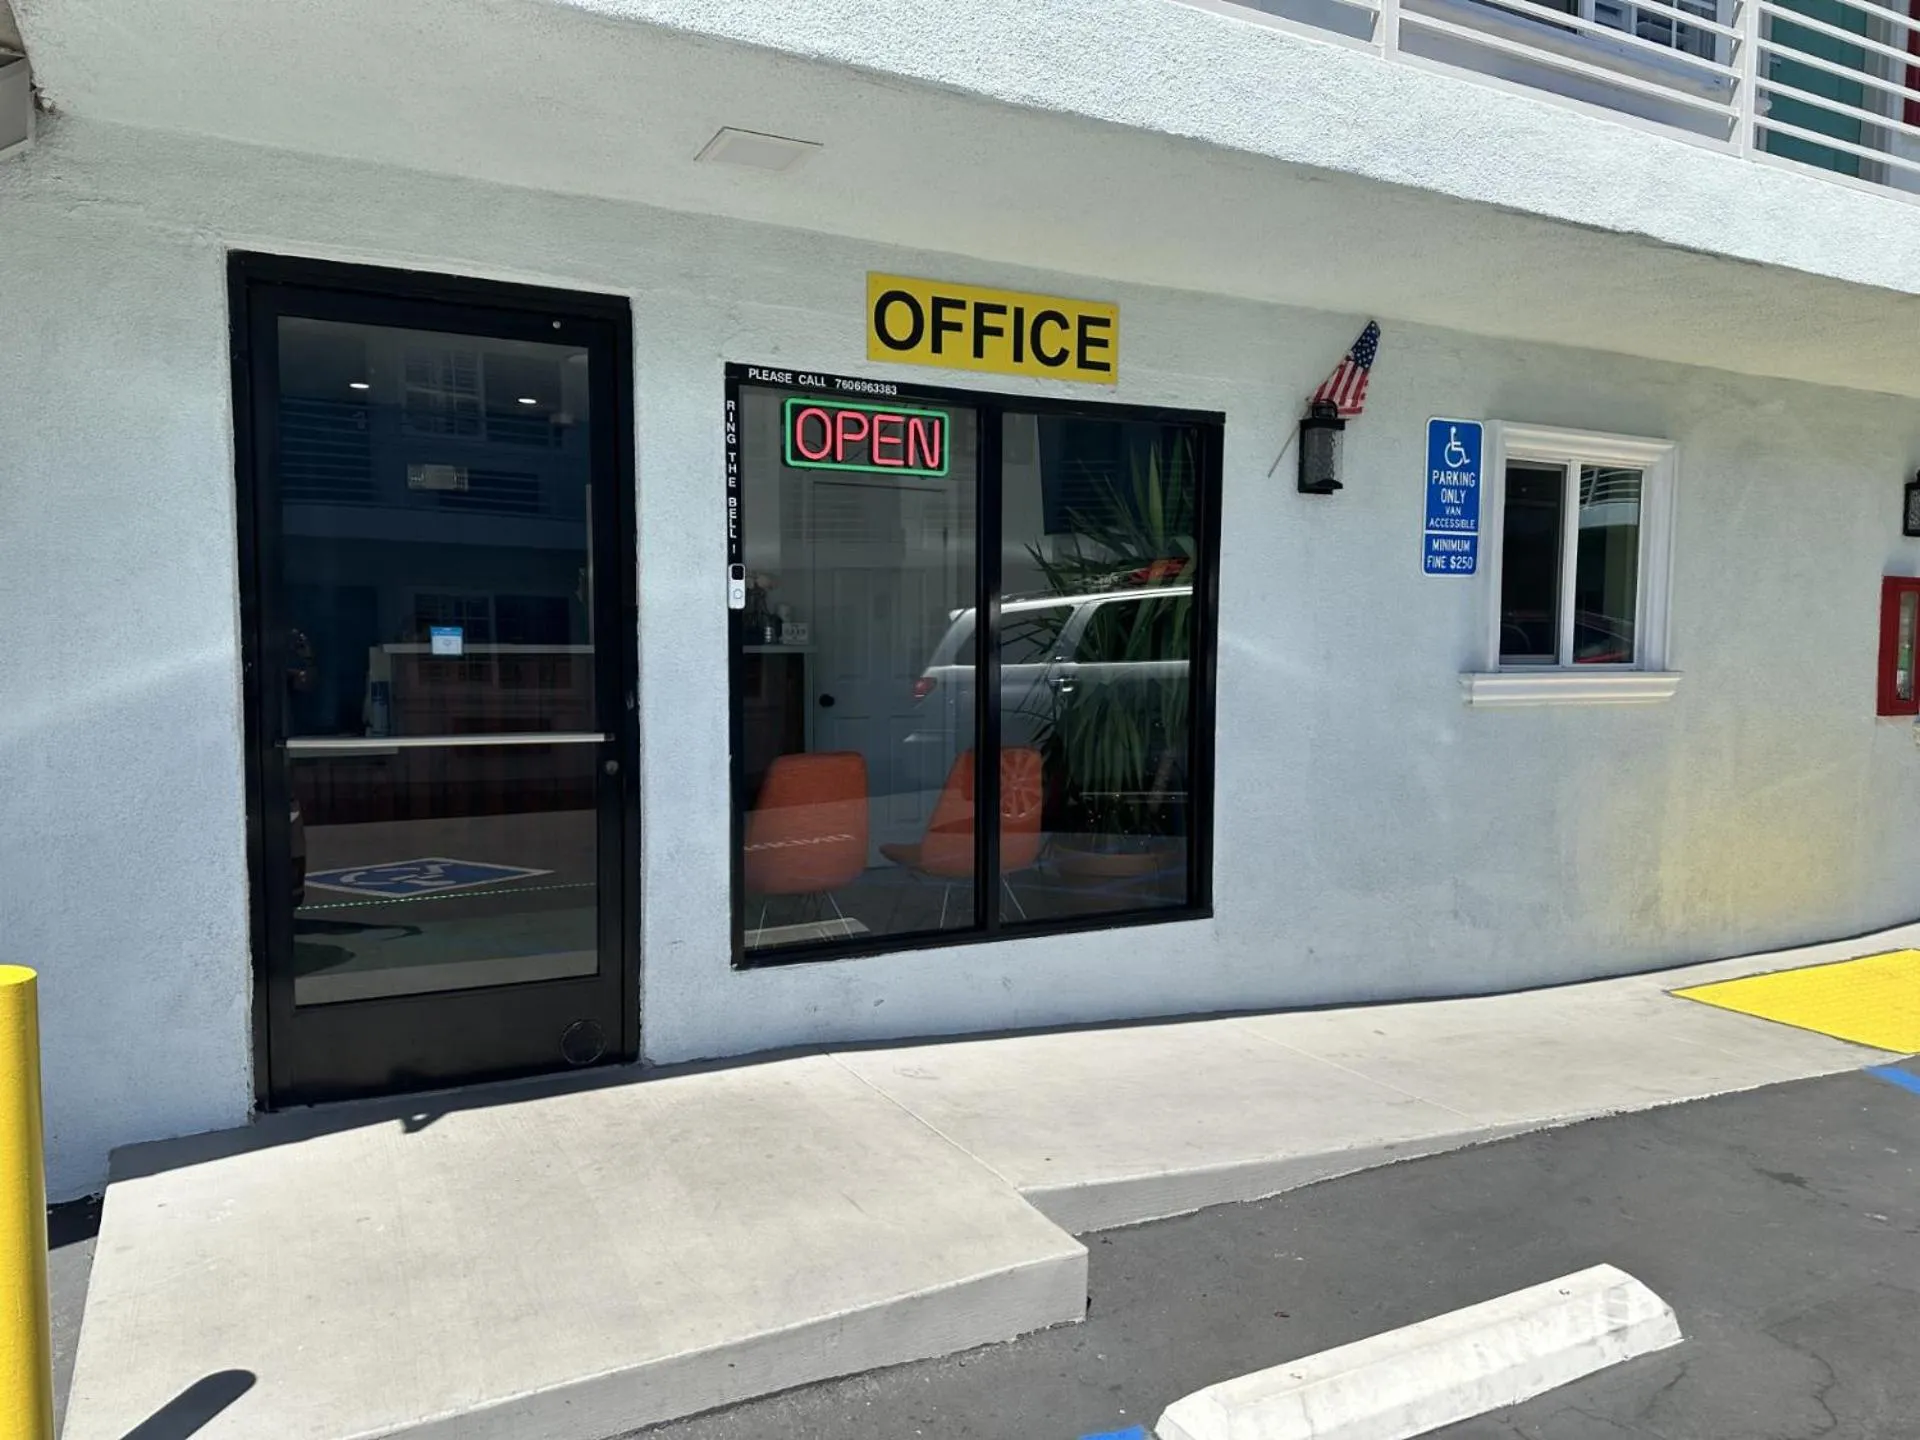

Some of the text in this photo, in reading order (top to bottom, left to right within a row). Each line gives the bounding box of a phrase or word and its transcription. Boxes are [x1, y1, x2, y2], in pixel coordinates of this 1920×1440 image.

[873, 290, 1112, 372] OFFICE
[748, 367, 898, 396] PLEASE CALL 7606963383
[726, 400, 737, 444] RING
[795, 407, 941, 468] OPEN
[727, 452, 737, 488] THE
[1432, 470, 1476, 488] PARKING
[1440, 488, 1467, 504] ONLY
[728, 497, 738, 539] BELL
[1445, 506, 1462, 516] VAN
[1429, 518, 1476, 529] ACCESSIBLE
[1432, 538, 1471, 552] MINIMUM
[1427, 555, 1474, 570] FINE $250
